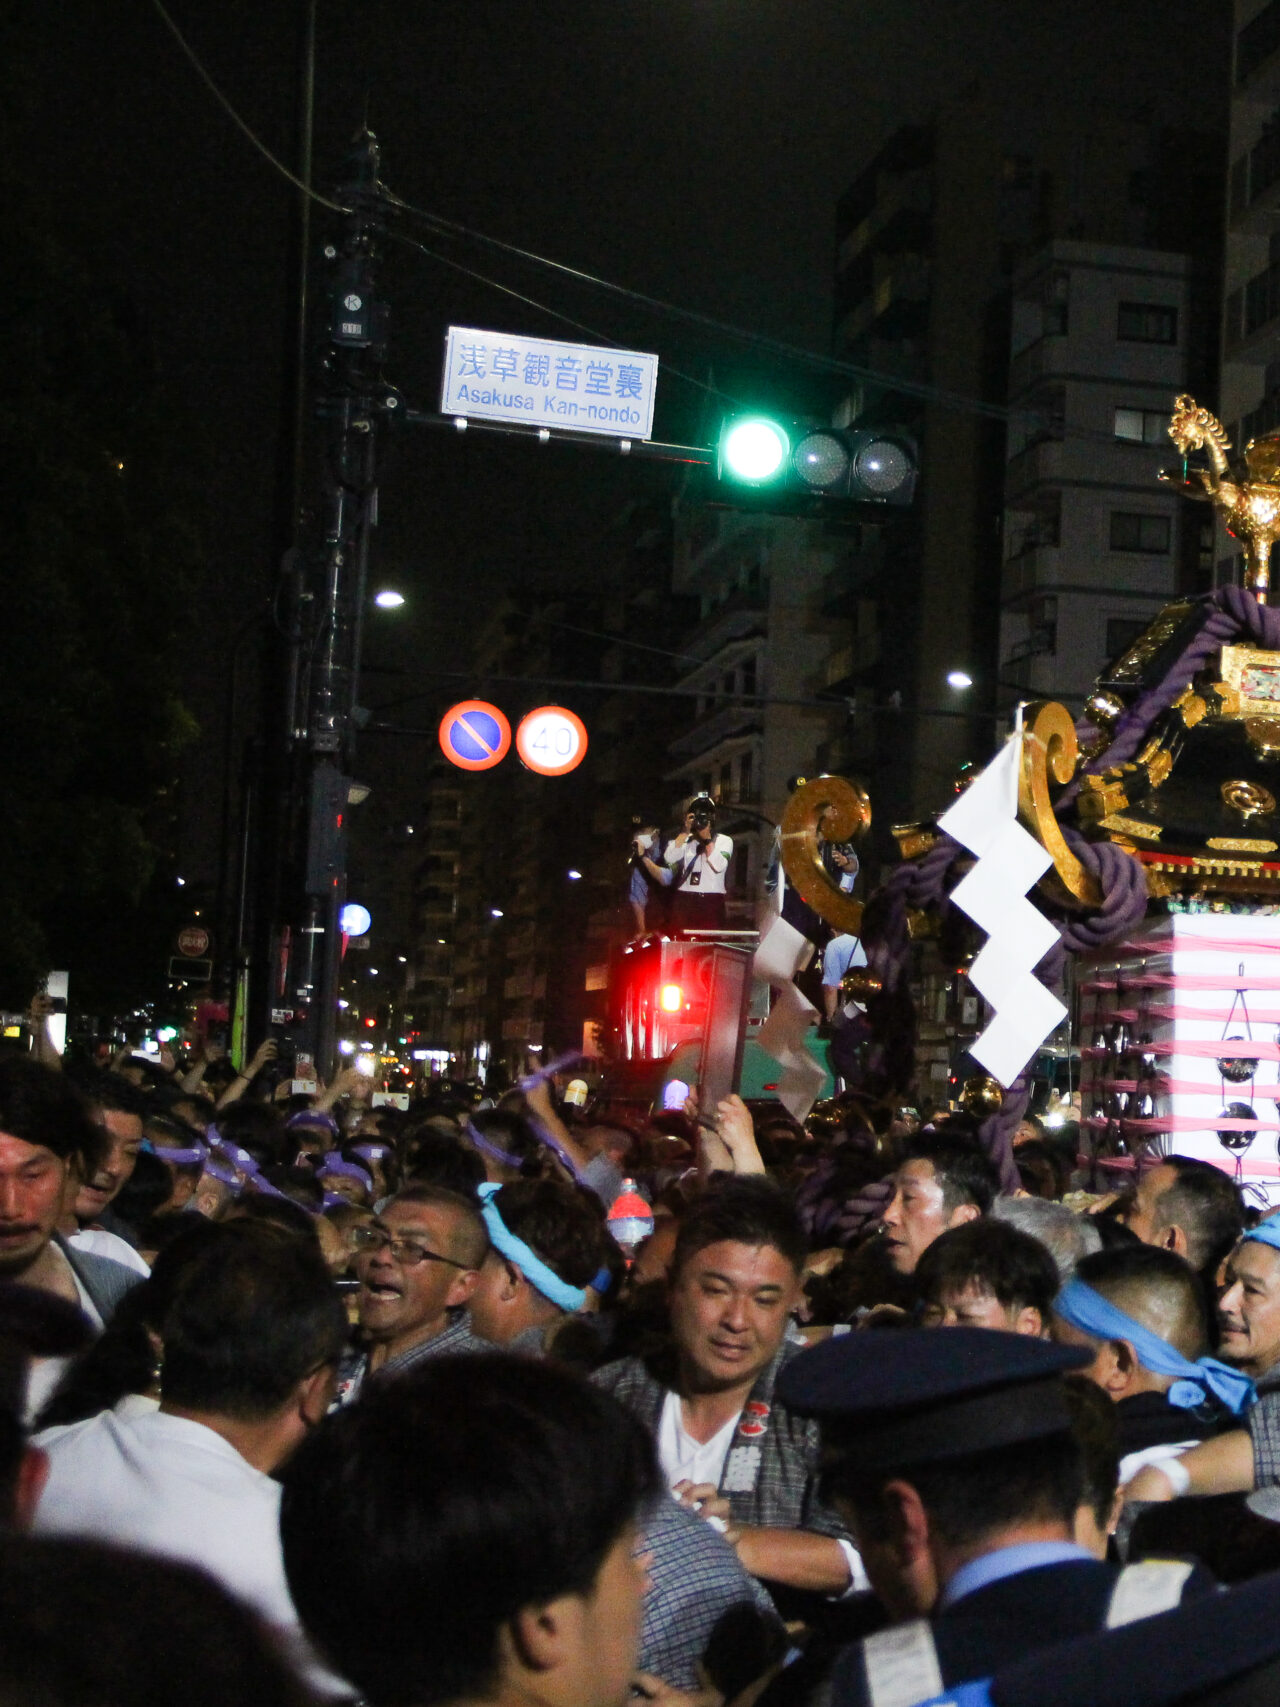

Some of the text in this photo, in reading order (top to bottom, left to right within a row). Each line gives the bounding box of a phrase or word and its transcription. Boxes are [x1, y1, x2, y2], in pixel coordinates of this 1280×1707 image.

[457, 342, 645, 401] 浅草観音堂裏
[457, 384, 641, 425] Asakusa Kan-nondo
[533, 727, 572, 756] 40
